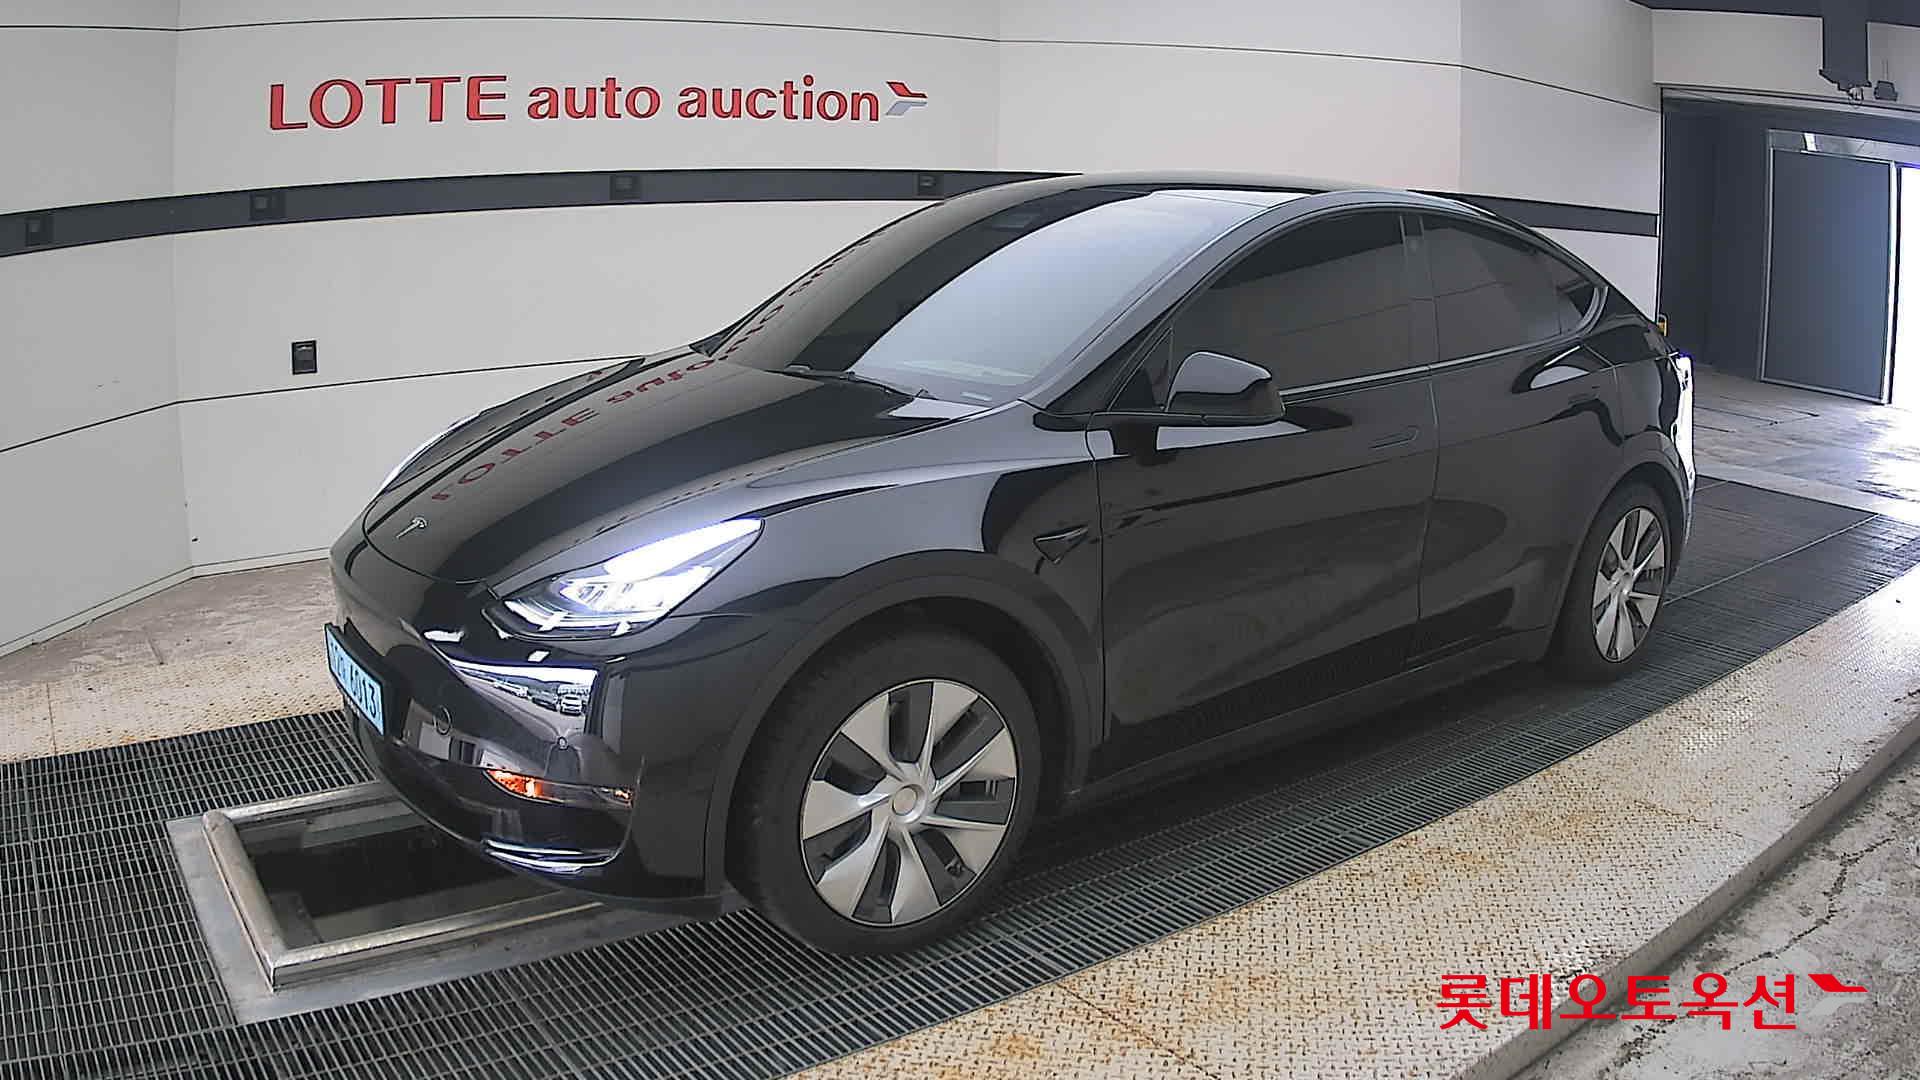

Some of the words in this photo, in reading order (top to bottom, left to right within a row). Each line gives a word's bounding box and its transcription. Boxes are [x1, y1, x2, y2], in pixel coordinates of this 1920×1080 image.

[269, 75, 507, 130] LOTTE
[527, 76, 661, 120] auto
[676, 75, 879, 122] auction
